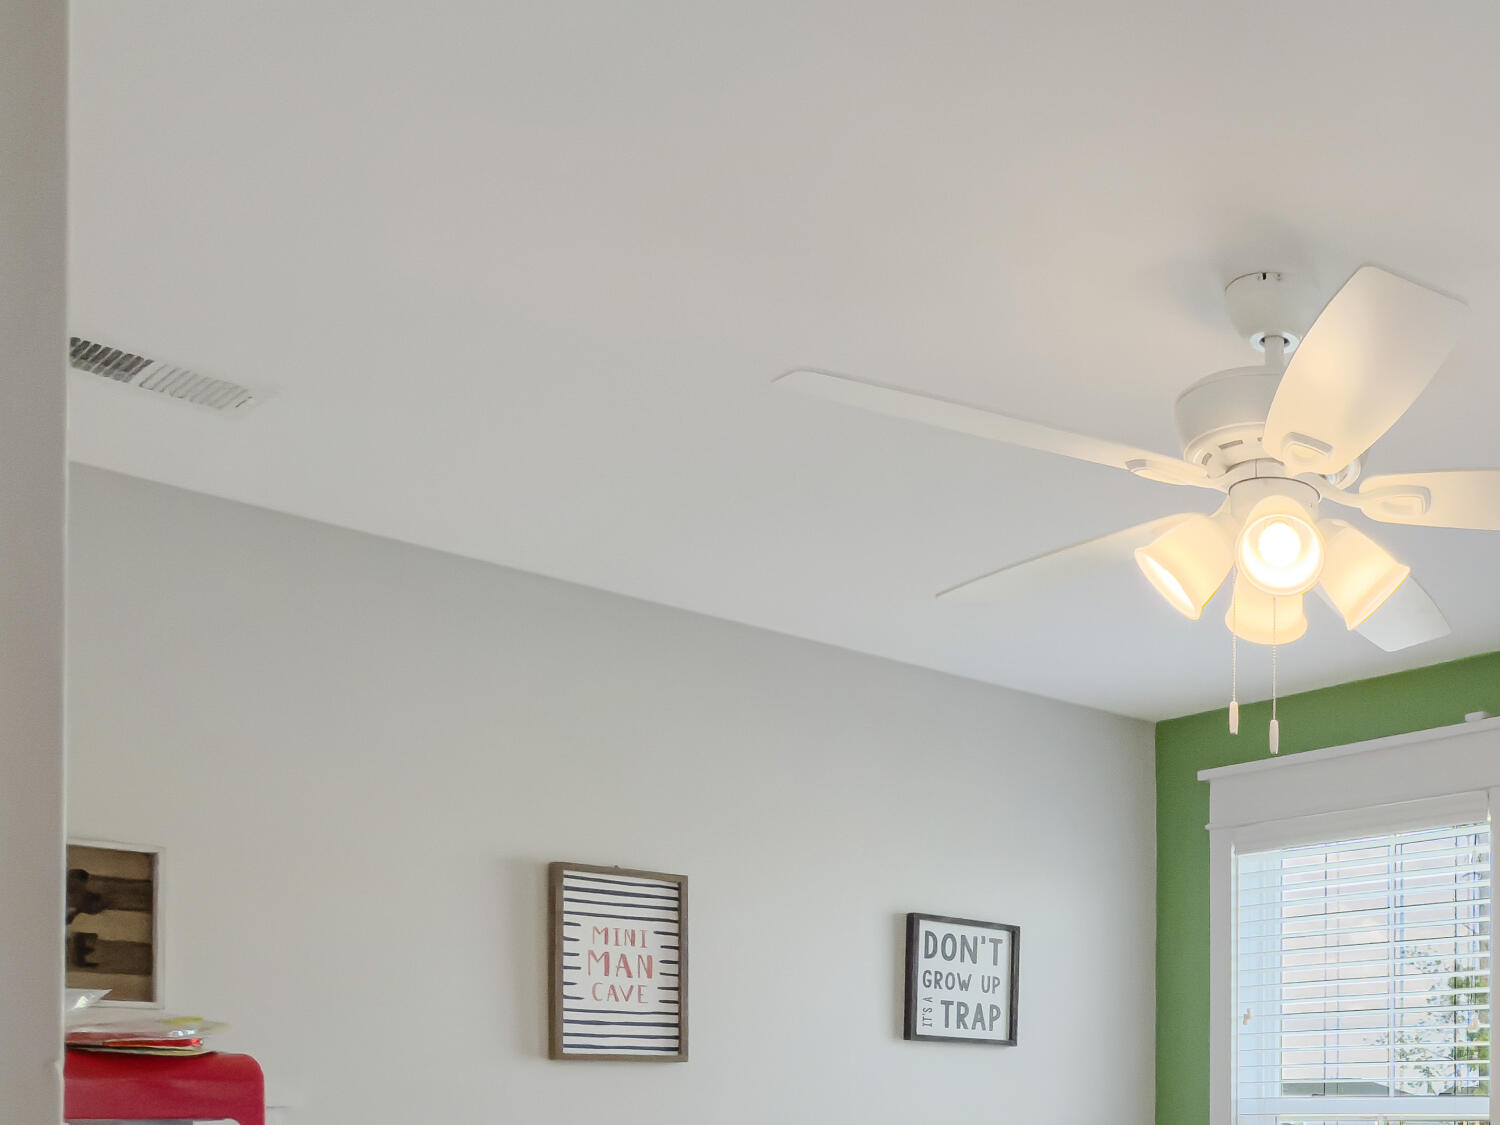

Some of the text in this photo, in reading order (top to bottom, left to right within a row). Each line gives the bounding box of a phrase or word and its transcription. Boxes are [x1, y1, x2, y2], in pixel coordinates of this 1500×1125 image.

[592, 925, 648, 948] MINI
[924, 930, 1003, 966] DON'T
[587, 949, 653, 979] MAN
[591, 982, 649, 1004] CAVE
[923, 969, 1001, 994] GROW UP
[922, 1007, 933, 1027] IT'S
[940, 1000, 1001, 1032] TRAP
